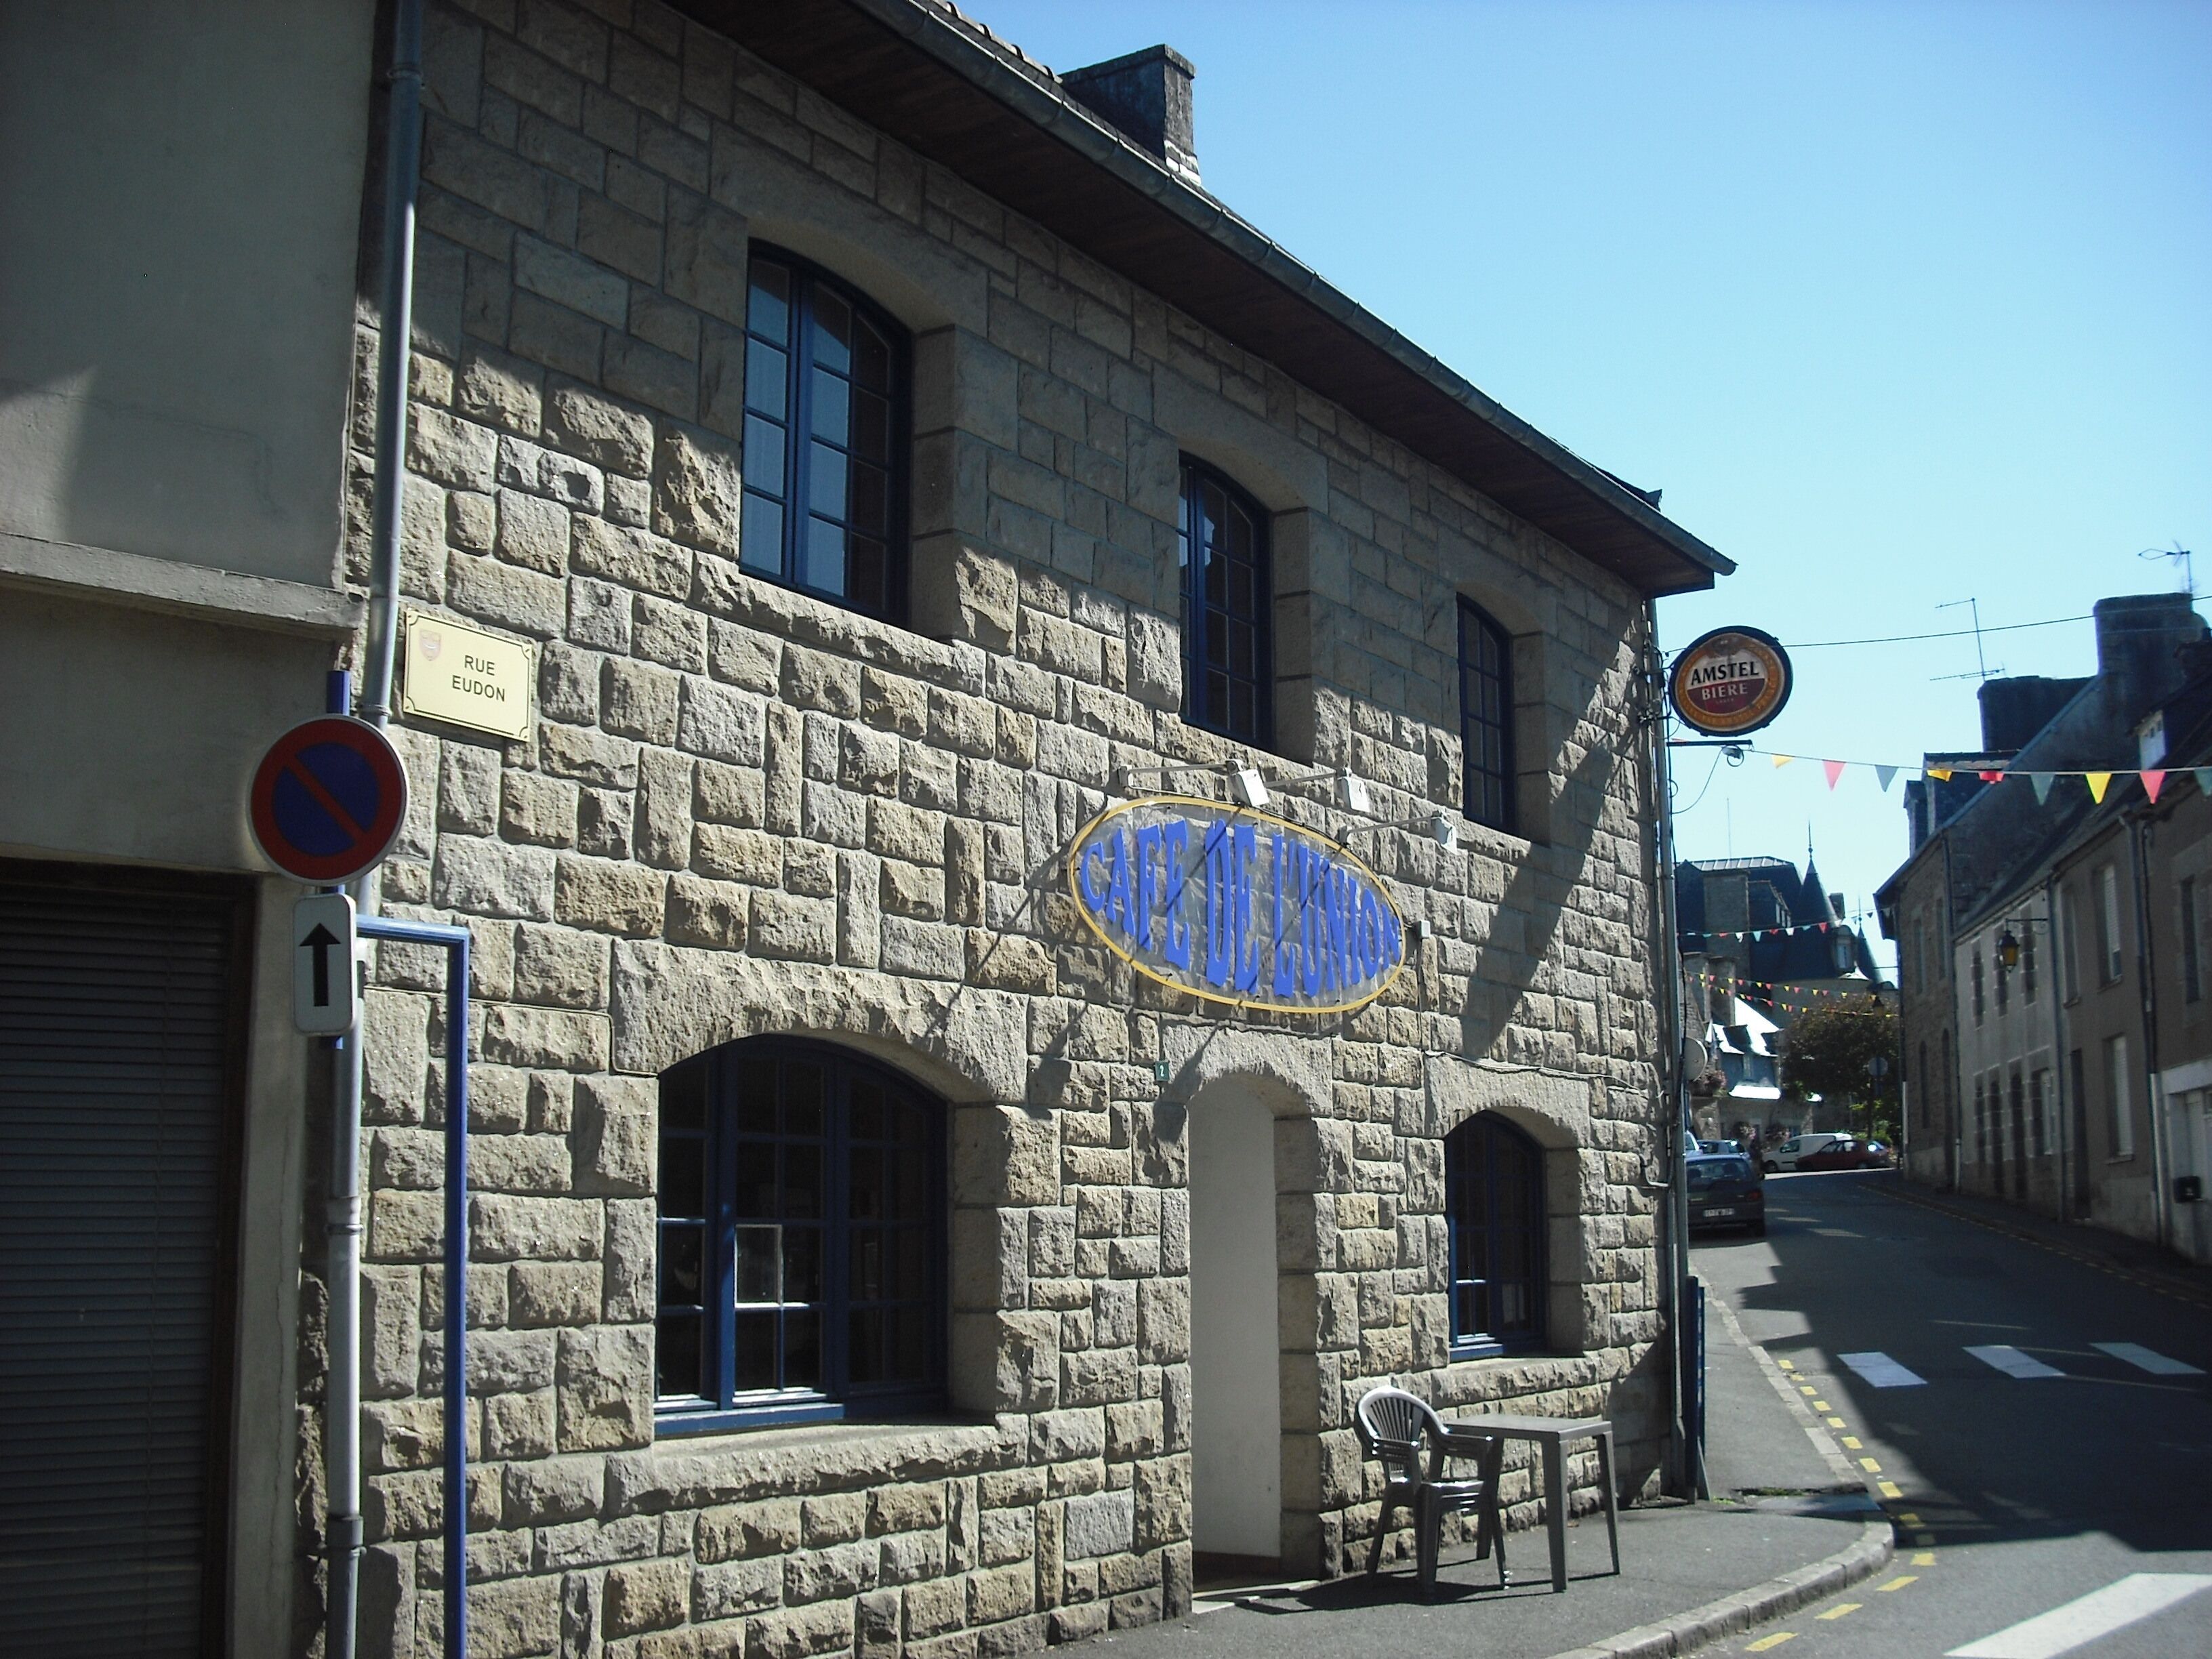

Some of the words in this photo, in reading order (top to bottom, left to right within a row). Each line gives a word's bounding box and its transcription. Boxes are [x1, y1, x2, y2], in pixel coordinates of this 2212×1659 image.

[464, 655, 495, 676] RUE
[1691, 661, 1760, 686] AMSTEL
[452, 674, 505, 702] EUDON
[1702, 682, 1748, 700] BIERE
[1080, 819, 1190, 971] CAFE
[1204, 818, 1258, 995] DE
[1272, 832, 1400, 998] L'UNION
[1160, 1065, 1164, 1077] 2
